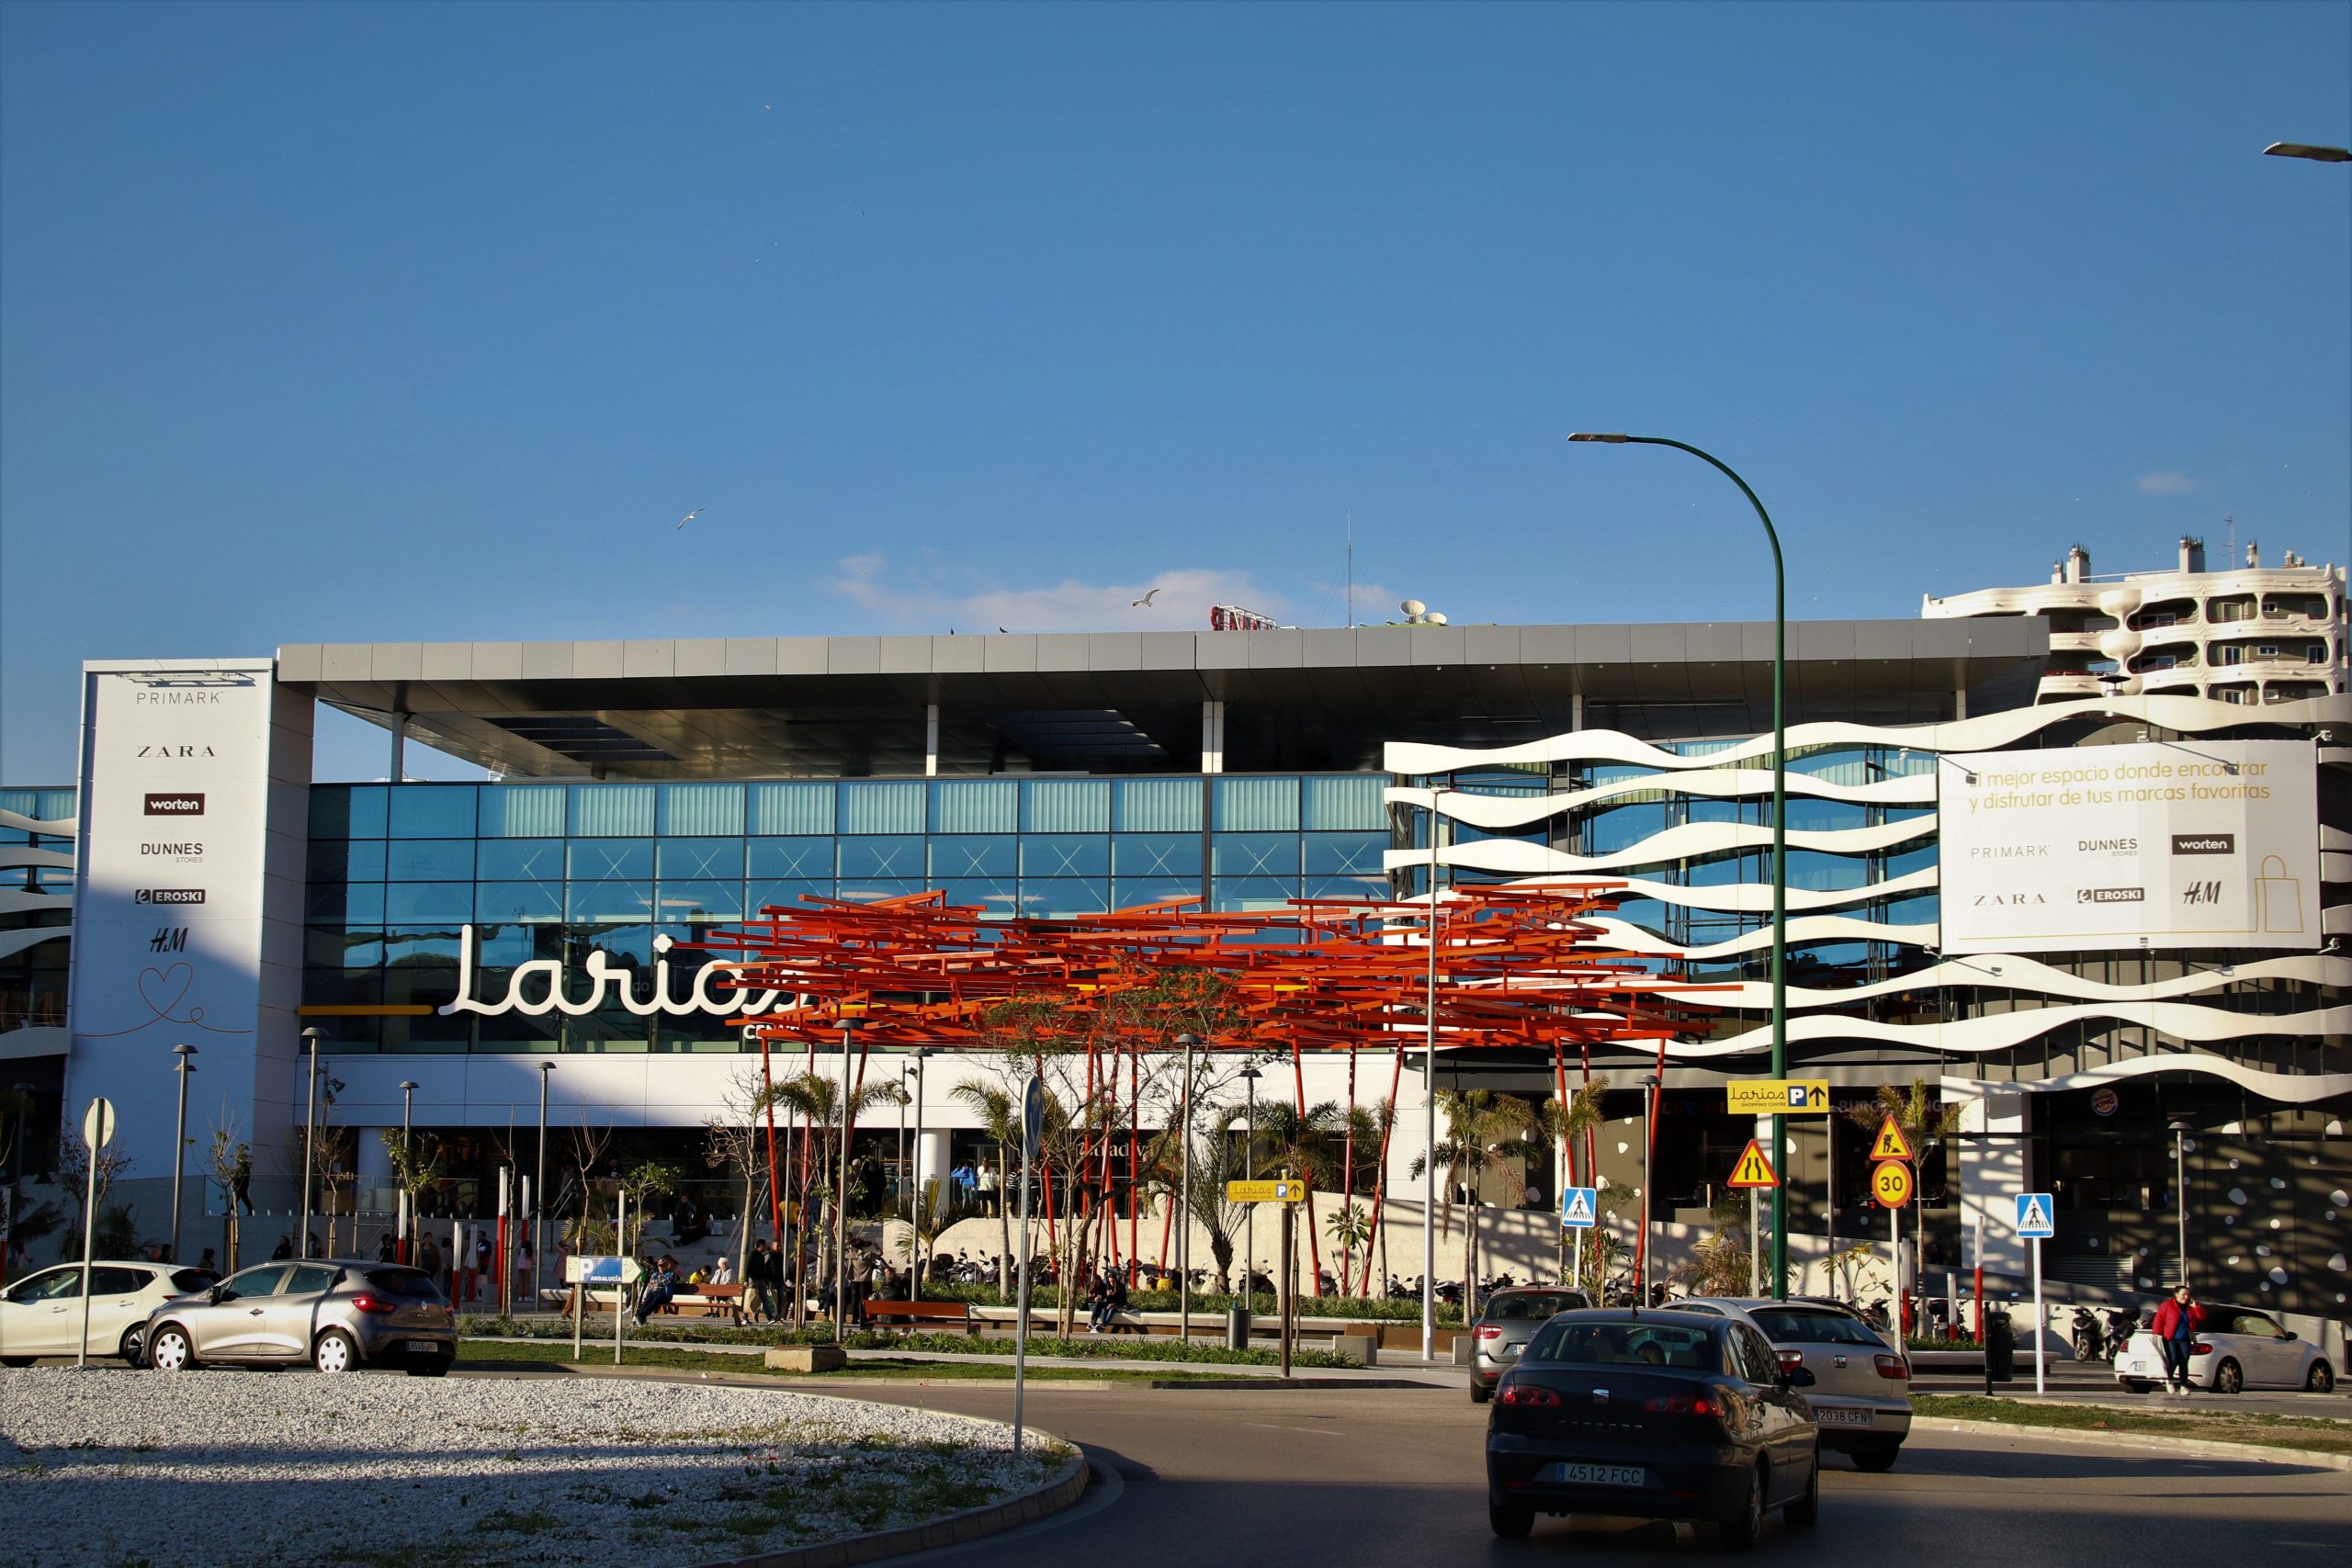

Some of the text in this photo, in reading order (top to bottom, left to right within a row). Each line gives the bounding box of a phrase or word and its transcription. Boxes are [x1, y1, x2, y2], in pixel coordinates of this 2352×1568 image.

[136, 692, 220, 705] PRIMARK
[137, 745, 217, 758] ZARA
[1987, 770, 2035, 790] mejor
[2041, 765, 2109, 787] espacio
[2115, 761, 2173, 780] donde
[150, 798, 199, 810] worten
[1969, 783, 2271, 814] y disfrutar de tus marcas favoritas
[141, 842, 204, 855] DUNNES
[1971, 845, 2049, 859] PRIMARK
[2078, 838, 2139, 852] DUNNES
[2178, 839, 2228, 851] worten
[155, 891, 203, 902] EROSKI
[1973, 893, 2047, 907] ZARA
[2096, 889, 2142, 902] EROSKI
[2182, 880, 2222, 906] H&M
[150, 926, 189, 953] H&M
[1730, 1087, 1787, 1101] Larios
[1880, 1175, 1904, 1192] 30
[580, 1258, 594, 1281] P
[1820, 1410, 1867, 1423] 2038 CFN
[1569, 1466, 1640, 1483] 4512 FCC
